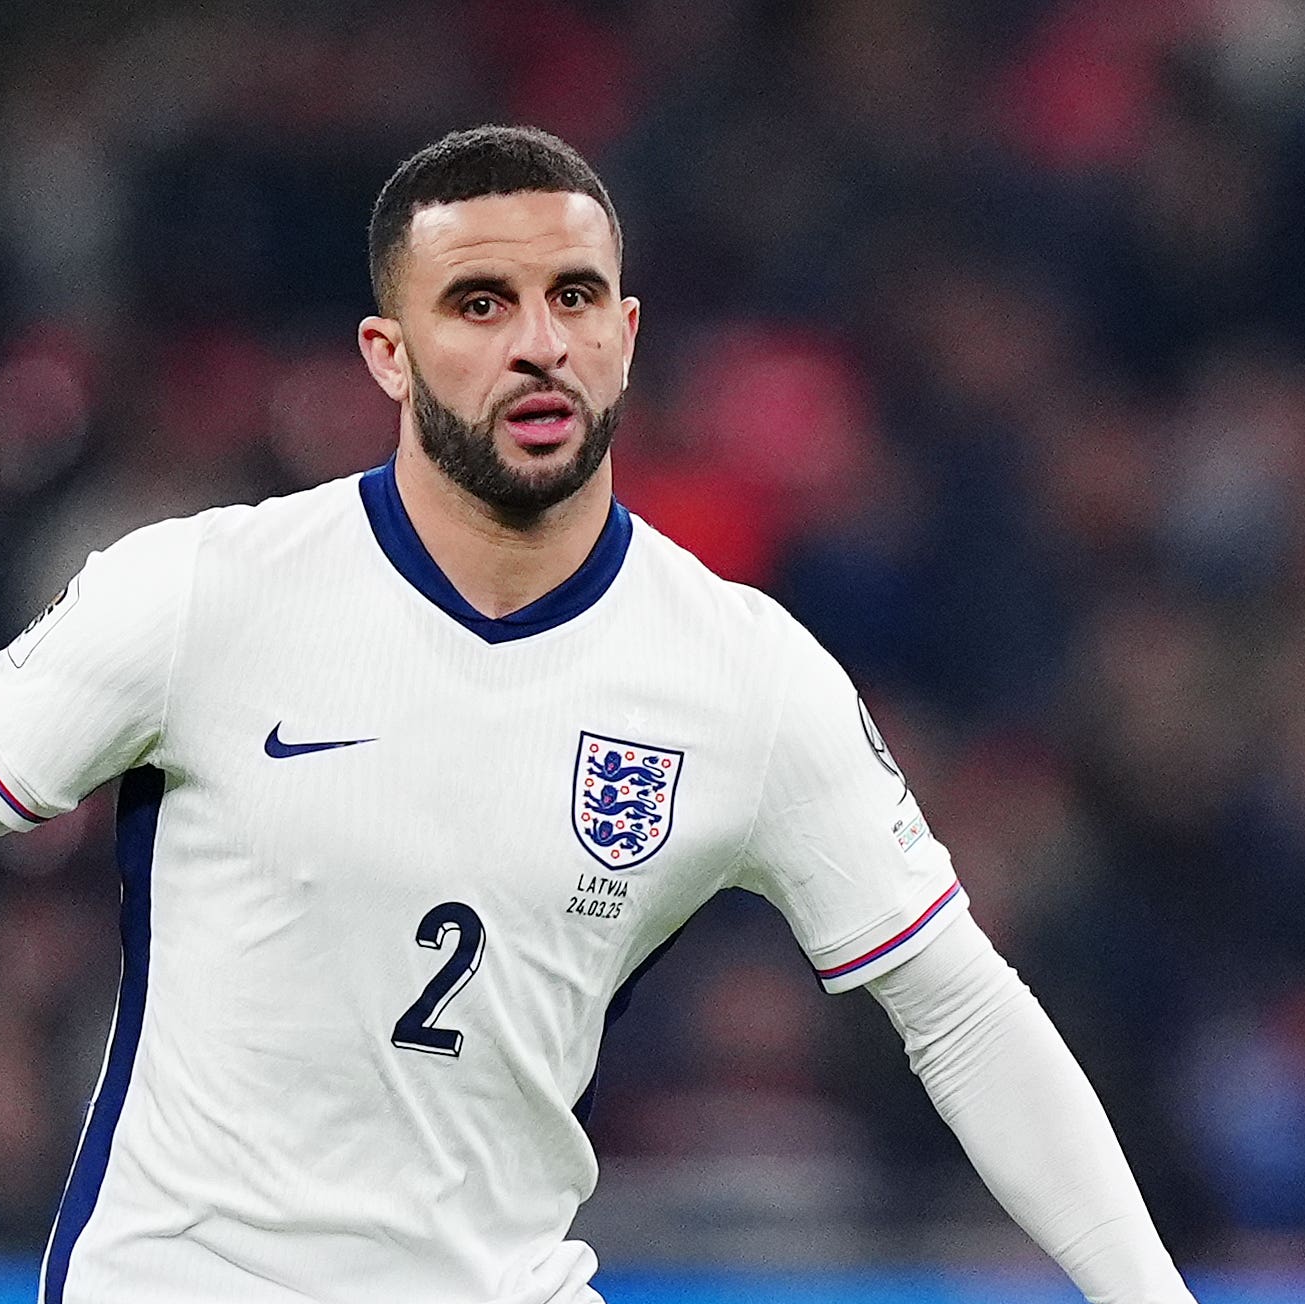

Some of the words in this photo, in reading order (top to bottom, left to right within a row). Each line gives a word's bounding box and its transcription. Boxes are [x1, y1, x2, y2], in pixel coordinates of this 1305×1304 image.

[576, 873, 629, 897] LATVIA
[566, 896, 623, 919] 24.03.25
[391, 901, 487, 1058] 2
